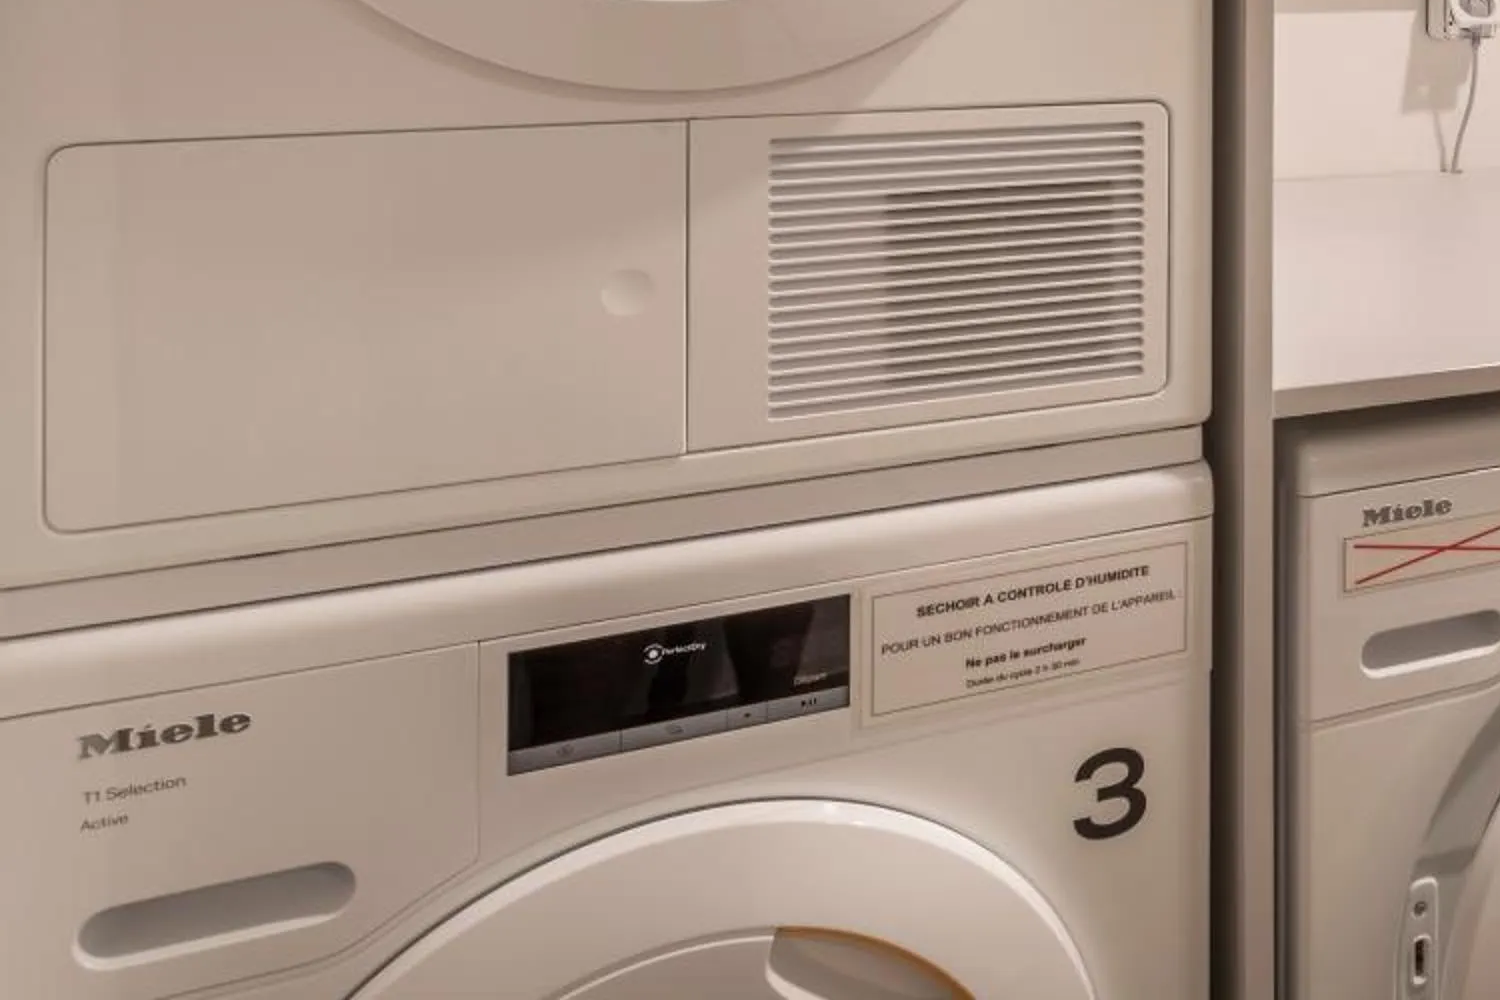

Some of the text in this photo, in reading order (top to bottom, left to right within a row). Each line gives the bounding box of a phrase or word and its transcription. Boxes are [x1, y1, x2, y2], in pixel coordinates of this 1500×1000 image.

[1362, 500, 1453, 527] Miele
[916, 565, 1149, 618] SECHOIR A CONTROLE D'HUMIDITE
[880, 589, 1175, 656] POUR UN BON FONCTIONNEMENT DE L'APPAREIL
[965, 636, 1087, 670] Ne pas le surcharger
[77, 713, 251, 760] Miele
[83, 776, 187, 804] T1 Selection
[1073, 747, 1147, 841] 3
[80, 813, 129, 832] Active
